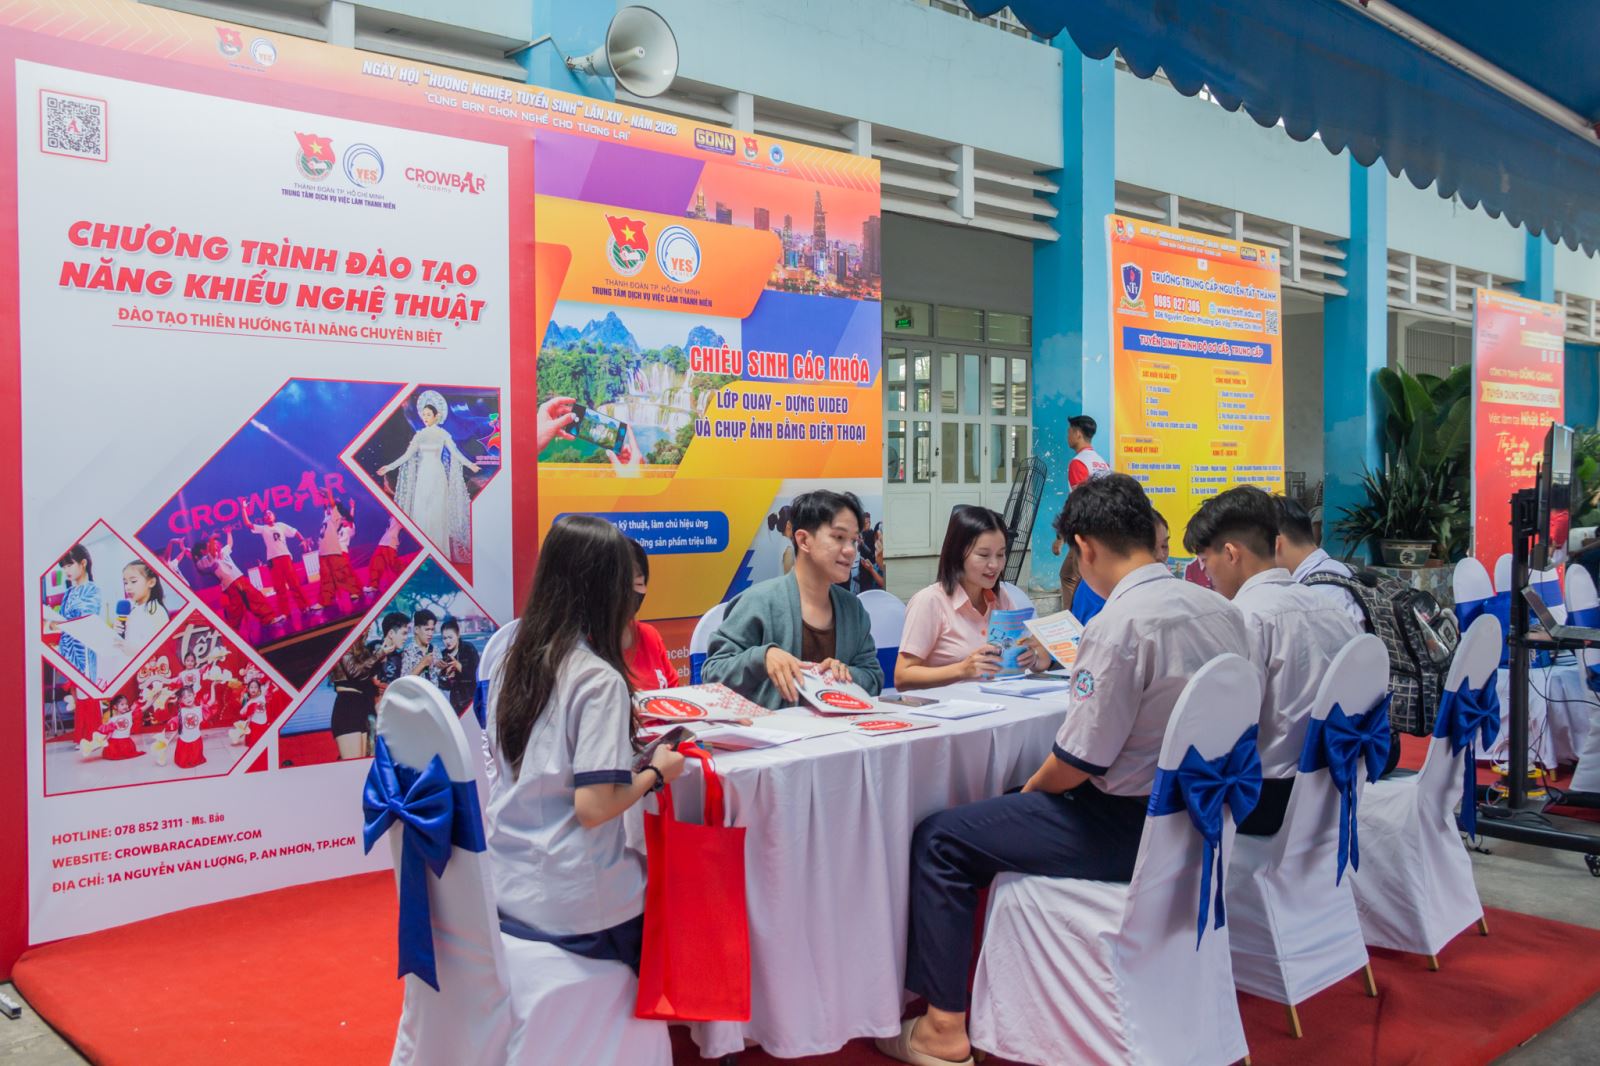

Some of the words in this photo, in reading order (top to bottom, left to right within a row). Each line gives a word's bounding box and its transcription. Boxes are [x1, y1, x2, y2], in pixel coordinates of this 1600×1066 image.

[362, 60, 397, 80] NGÀY
[400, 67, 419, 85] HỘI
[584, 104, 604, 121] LẦN
[606, 110, 622, 124] XIV
[630, 114, 652, 131] NĂM
[655, 122, 677, 136] 2026
[488, 105, 517, 119] CHỌN
[552, 118, 573, 129] CHO
[356, 167, 378, 181] YES
[405, 167, 485, 195] CROWBAR
[282, 188, 301, 198] TRUNG
[301, 189, 314, 199] TÂM
[315, 191, 329, 202] DỊCH
[329, 193, 337, 204] VỤ
[338, 193, 351, 205] VIỆC
[352, 195, 363, 206] LÀM
[364, 198, 382, 208] THANH
[383, 200, 396, 210] NIÊN
[369, 191, 385, 201] MINH
[68, 220, 229, 261] CHƯƠNG
[241, 237, 338, 273] TRÌNH
[345, 248, 412, 279] ĐÀO
[422, 259, 477, 290] TẠO
[671, 257, 693, 273] YES
[59, 256, 173, 296] NĂNG
[184, 269, 288, 306] KHIẾU
[296, 284, 386, 320] NGHỆ
[394, 292, 486, 328] THUẬT
[605, 278, 629, 287] THÀNH
[684, 288, 701, 296] MINH
[1152, 271, 1180, 286] TRƯỜNG
[1182, 277, 1204, 290] TRUNG
[592, 286, 612, 296] TRUNG
[613, 286, 626, 298] TÂM
[628, 290, 641, 301] DỊCH
[643, 292, 651, 302] VỤ
[652, 292, 664, 303] VIỆC
[666, 294, 678, 303] LÀM
[680, 296, 698, 306] THANH
[118, 306, 154, 322] ĐÀO
[157, 310, 188, 327] TẠO
[191, 312, 235, 329] THIÊN
[239, 316, 292, 333] HƯỚNG
[294, 320, 316, 335] TÀI
[319, 322, 358, 337] NĂNG
[360, 326, 414, 341] CHUYÊN
[417, 328, 443, 345] BIỆT
[1162, 337, 1177, 348] SINH
[1231, 345, 1251, 357] TRUNG
[690, 345, 742, 375] CHIÊU
[748, 351, 788, 378] SINH
[794, 350, 825, 380] CÁC
[829, 354, 870, 383] KHÓA
[717, 388, 738, 409] LỚP
[742, 392, 771, 411] QUAY
[786, 394, 815, 416] DỰNG
[818, 396, 848, 414] VIDEO
[695, 417, 711, 437] VÀ
[715, 420, 746, 442] CHỤP
[750, 417, 773, 439] ẢNH
[809, 421, 833, 443] ĐIỆN
[837, 424, 866, 443] THOẠI
[168, 471, 346, 534] CROWBAR
[618, 519, 627, 531] kỹ
[628, 519, 650, 531] thuật,
[651, 519, 664, 529] làm
[665, 519, 678, 529] chủ
[679, 519, 694, 530] hiệu
[694, 519, 709, 530] ứng
[634, 537, 653, 549] hững
[655, 537, 668, 547] sản
[688, 536, 705, 548] triệu
[705, 536, 717, 545] like
[52, 828, 112, 845] HOTLINE:
[114, 824, 136, 836] 078
[138, 821, 159, 833] 852
[161, 818, 183, 830] 3111
[191, 816, 207, 825] Ms.
[209, 812, 225, 823] Bảo
[52, 851, 112, 869] WEBSITE:
[115, 829, 262, 859] CROWBARACADEMY.COM
[52, 880, 76, 893] ĐỊA
[78, 872, 104, 888] CHỈ:
[107, 873, 122, 883] 1A
[124, 861, 175, 881] NGUYỄN
[177, 859, 201, 872] VĂN
[250, 852, 259, 861] P.
[261, 848, 277, 859] AN
[279, 841, 315, 856] NHƠN,
[316, 836, 356, 850] TP.HCM
